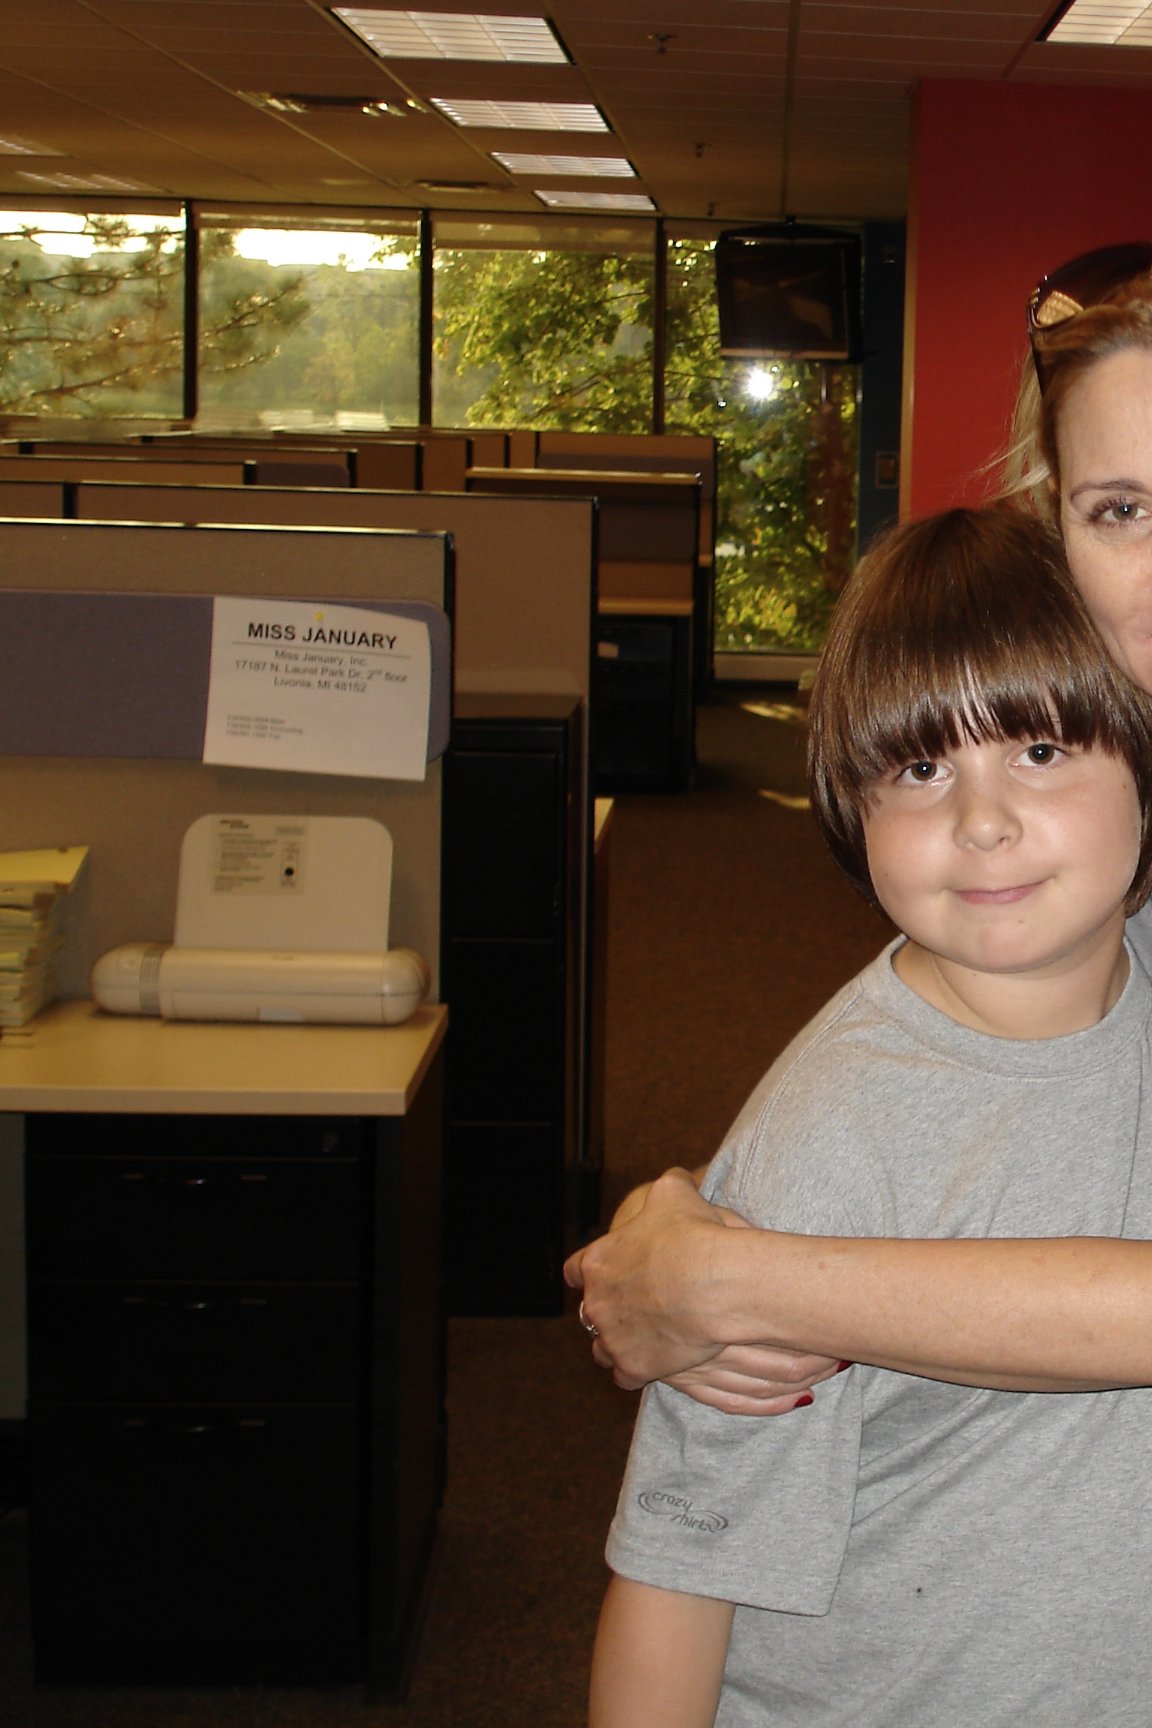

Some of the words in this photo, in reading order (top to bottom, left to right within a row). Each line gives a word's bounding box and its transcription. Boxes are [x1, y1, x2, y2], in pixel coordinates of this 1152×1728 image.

[247, 623, 296, 641] MISS
[302, 627, 397, 650] JANUARY
[274, 650, 299, 661] Miss
[285, 663, 318, 676] Laurel
[321, 666, 344, 678] Park
[384, 671, 407, 683] floor
[318, 679, 330, 690] MI
[652, 1491, 693, 1513] crazy
